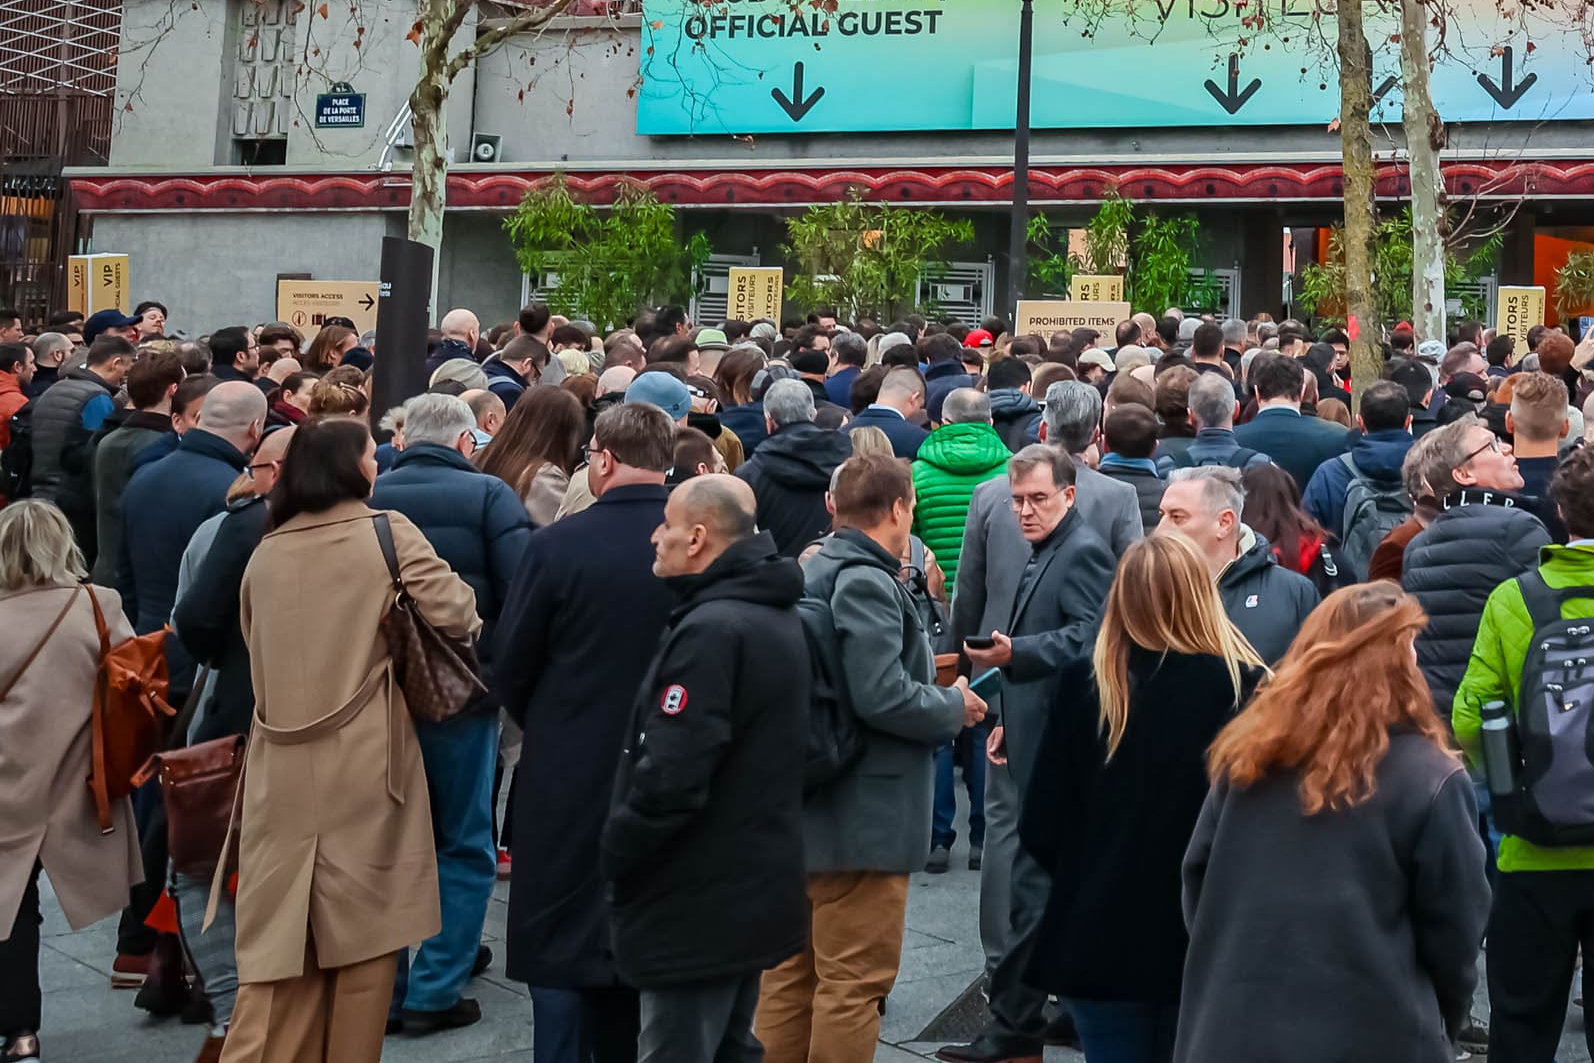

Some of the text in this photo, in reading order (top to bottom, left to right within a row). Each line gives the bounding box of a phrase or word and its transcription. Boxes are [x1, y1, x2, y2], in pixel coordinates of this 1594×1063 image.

[684, 10, 943, 40] OFFICIAL GUEST
[323, 106, 357, 115] DE LA PORTE
[332, 98, 349, 106] PLACE
[328, 115, 360, 124] VERSAILLES
[104, 264, 114, 287] VIP
[736, 275, 746, 321] SITORS
[747, 274, 756, 320] VISITEURS
[766, 276, 774, 317] ITORS
[1029, 317, 1115, 326] PROHIBITED ITEMS
[1519, 294, 1529, 342] VISITEURS
